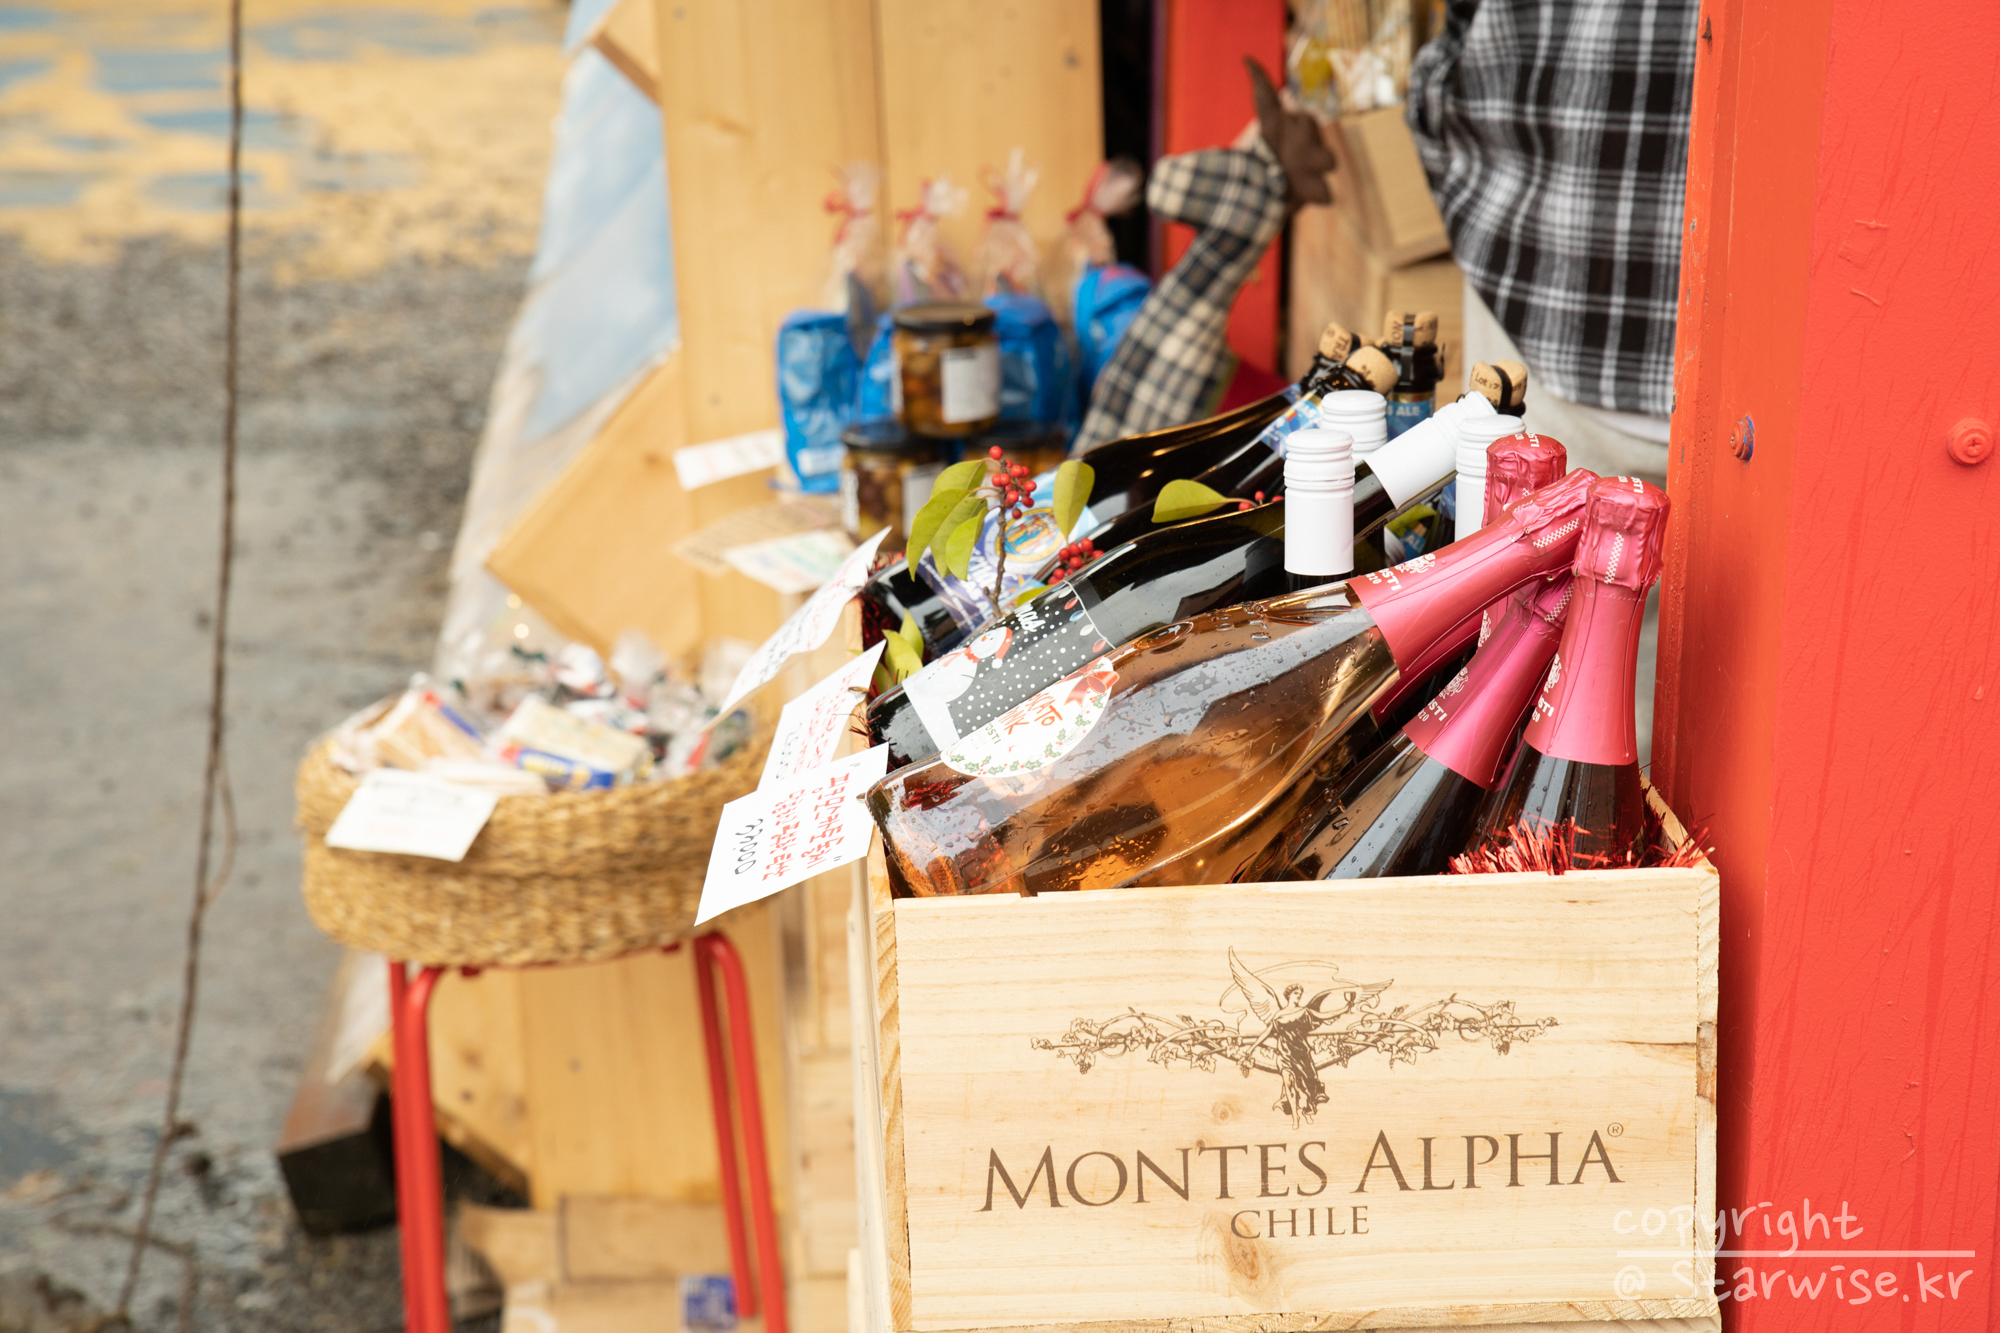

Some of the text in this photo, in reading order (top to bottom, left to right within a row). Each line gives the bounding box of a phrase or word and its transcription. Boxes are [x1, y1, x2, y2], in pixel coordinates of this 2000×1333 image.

[974, 1129, 1626, 1213] MONTES ALPHA
[1231, 1205, 1370, 1240] CHILE
